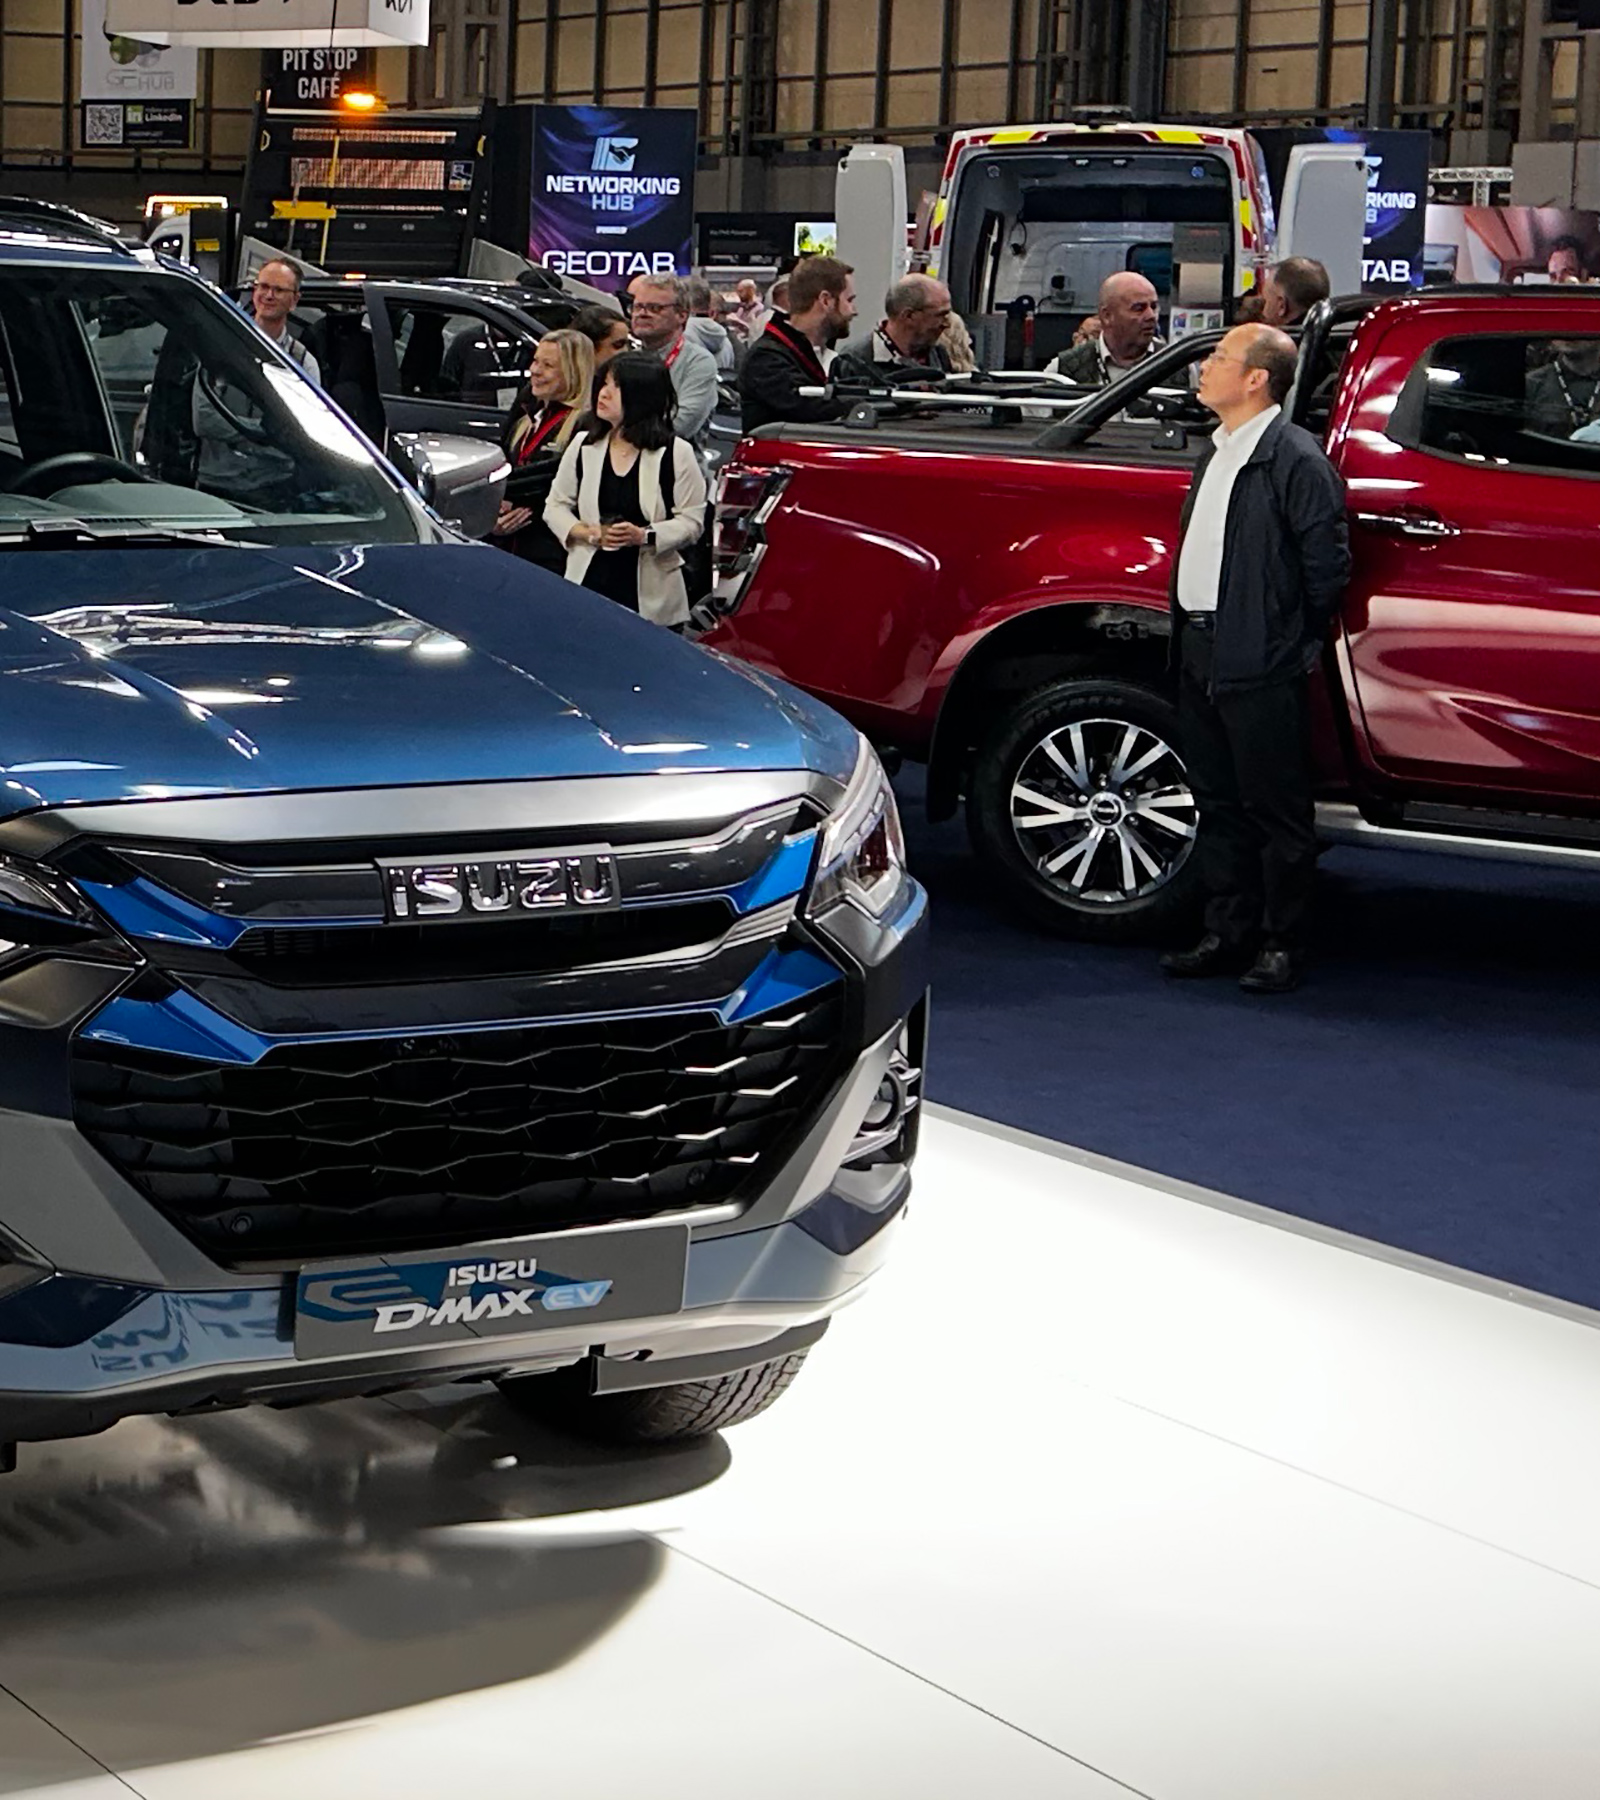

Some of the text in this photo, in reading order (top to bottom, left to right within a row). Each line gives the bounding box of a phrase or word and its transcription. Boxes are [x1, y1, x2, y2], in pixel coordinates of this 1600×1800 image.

[282, 48, 358, 71] PIT STOP
[298, 72, 340, 99] CAFÉ
[546, 175, 681, 195] NETWORKING
[592, 194, 635, 211] HUB
[1365, 192, 1417, 209] RKING
[542, 250, 675, 275] GEOTAB
[1361, 260, 1411, 282] TAB
[389, 856, 613, 917] ISUZU
[448, 1258, 538, 1287] ISUZU
[548, 1283, 603, 1308] EV
